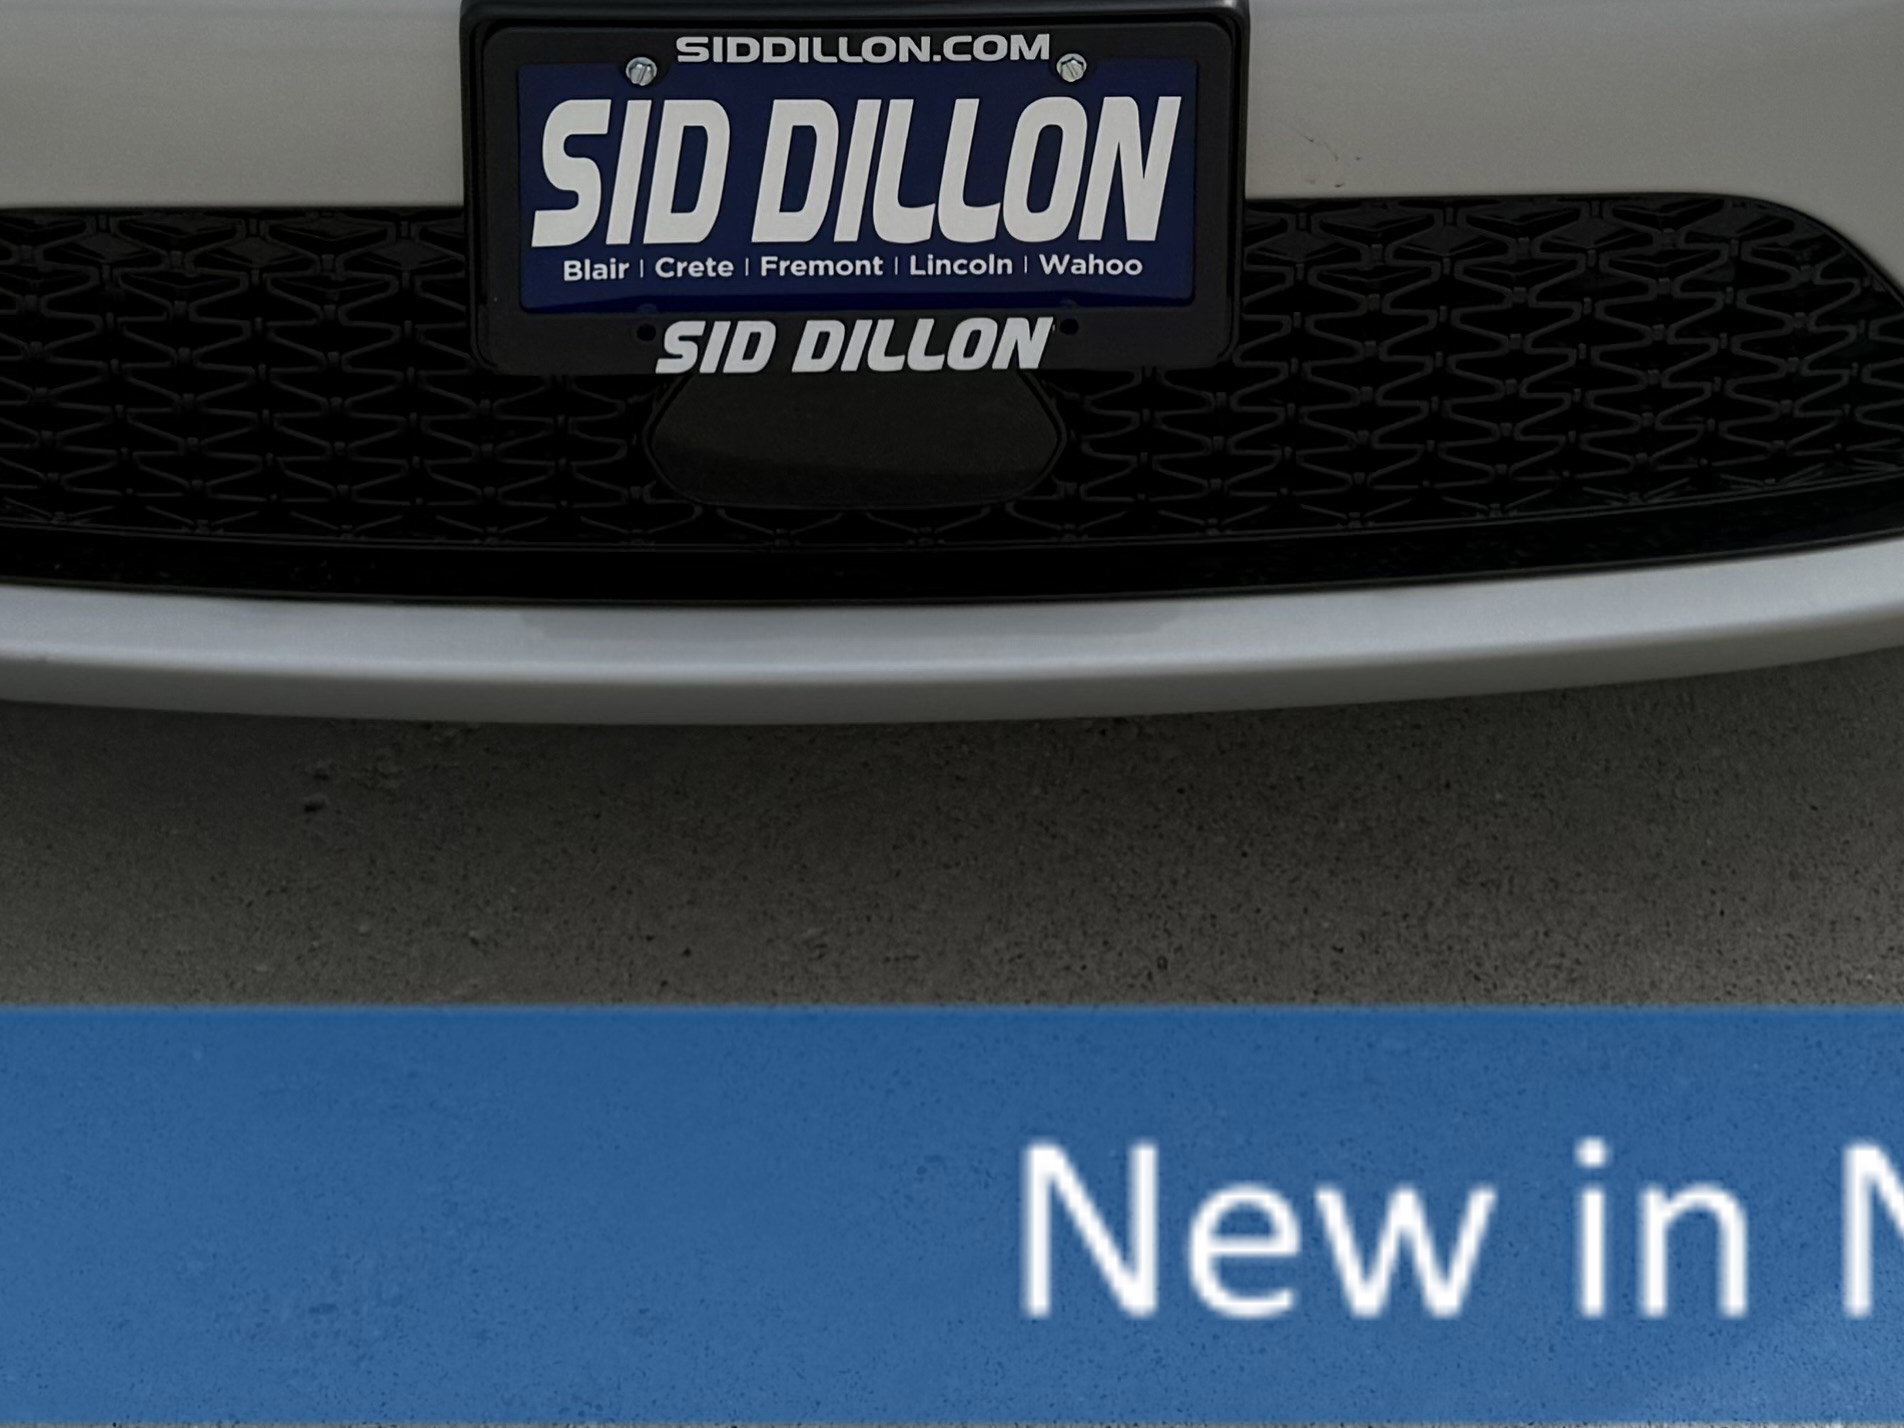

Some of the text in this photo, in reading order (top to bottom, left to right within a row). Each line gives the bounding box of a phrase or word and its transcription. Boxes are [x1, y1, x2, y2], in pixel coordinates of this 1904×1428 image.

[676, 33, 1050, 64] SIDDILLON.COM
[531, 96, 1182, 248] SID DILLON
[563, 253, 1143, 282] Blair Crete Fremont Lincoln Wahoo
[655, 316, 1054, 375] SID DILLON
